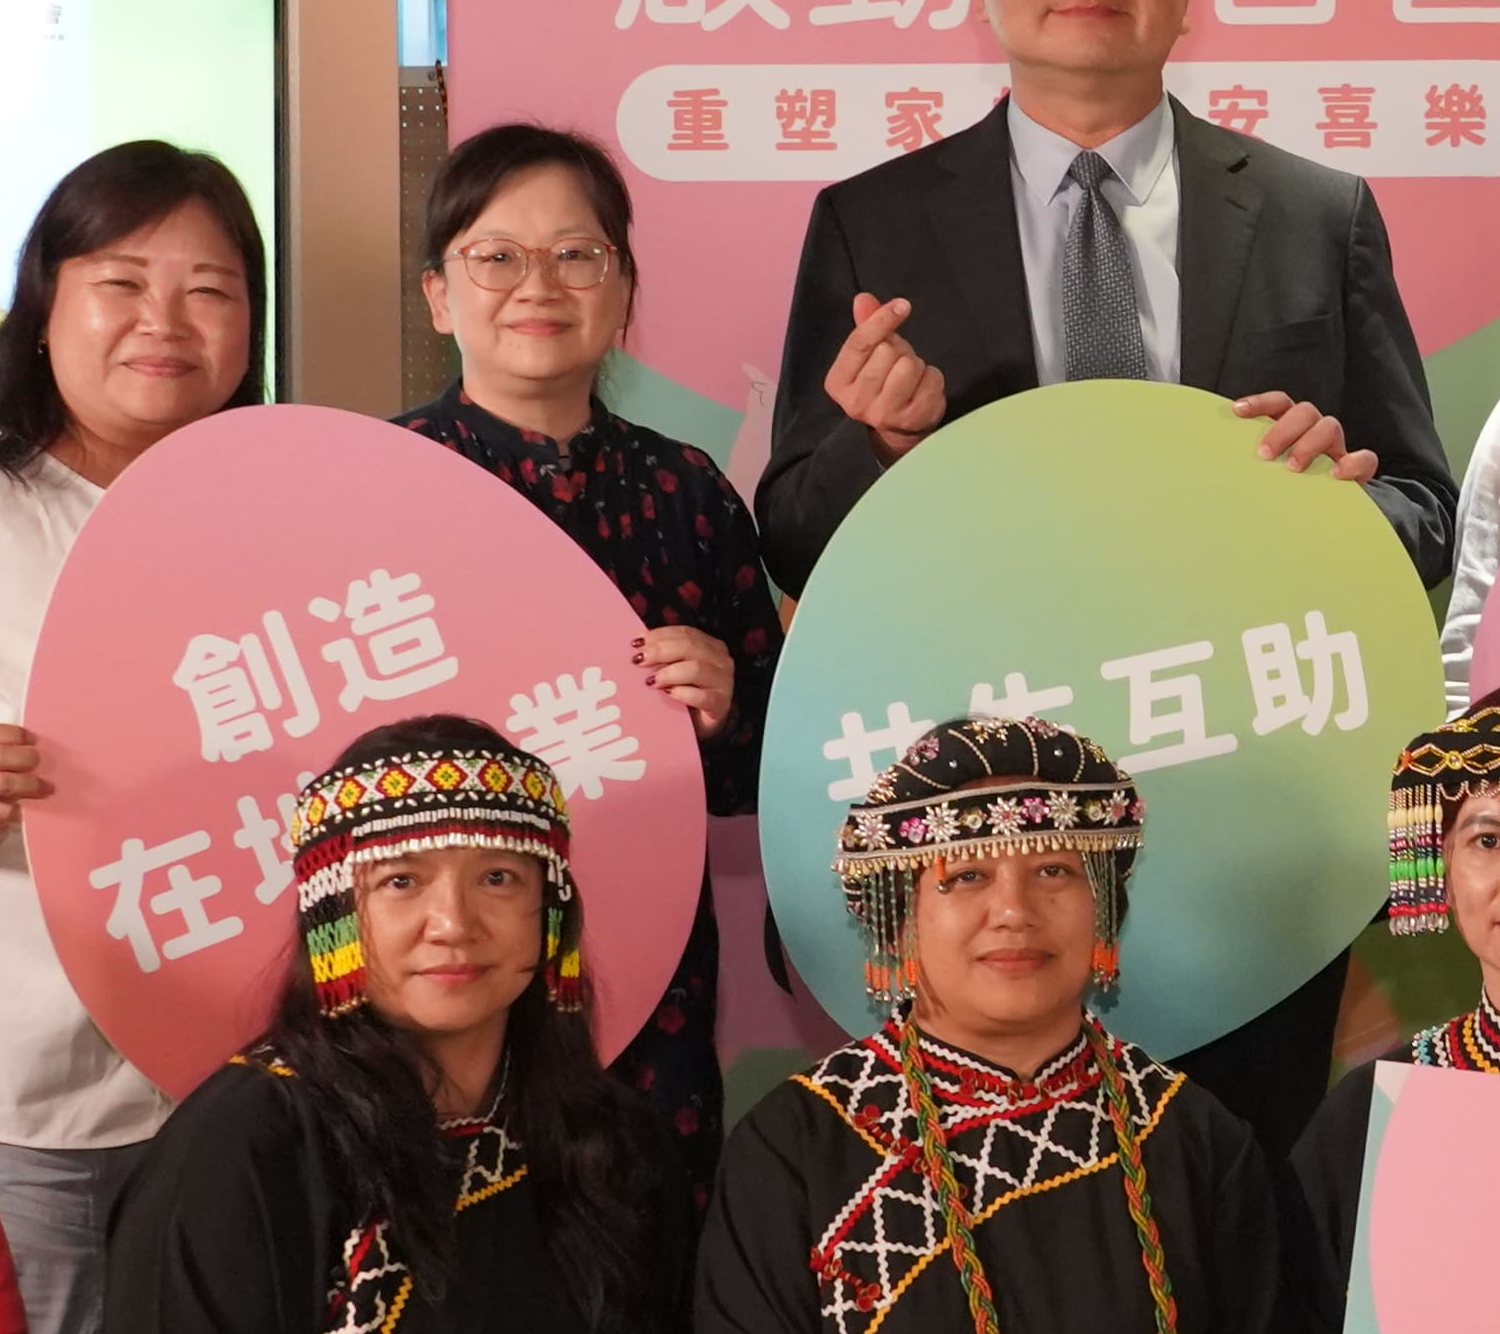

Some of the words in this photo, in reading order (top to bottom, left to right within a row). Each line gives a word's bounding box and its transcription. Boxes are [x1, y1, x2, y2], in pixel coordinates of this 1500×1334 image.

[666, 83, 1487, 151] 重塑家安喜樂
[172, 569, 459, 763] 創造
